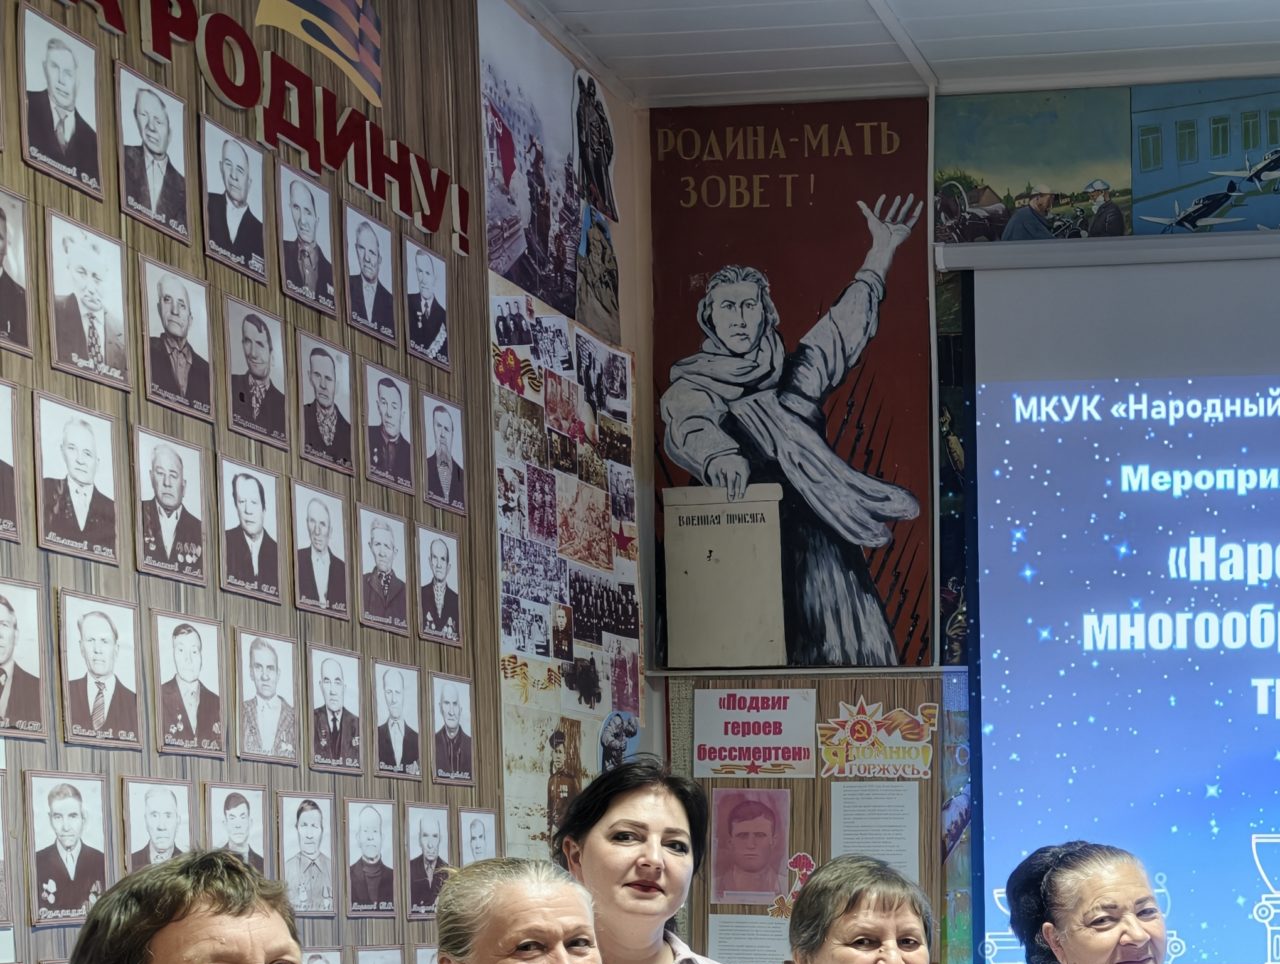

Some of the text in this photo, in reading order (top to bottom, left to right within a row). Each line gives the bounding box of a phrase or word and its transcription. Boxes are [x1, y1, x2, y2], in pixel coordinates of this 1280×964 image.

[141, 0, 469, 256] РОДИНУ!
[656, 121, 900, 162] РОДИНА-МАТЬ
[1014, 394, 1102, 423] МКУК
[678, 512, 766, 527] ВОЕННАЯ ПРИСЯГА
[719, 693, 790, 713] «Подвиг
[723, 719, 783, 737] героев
[697, 743, 811, 763] бессмертен»
